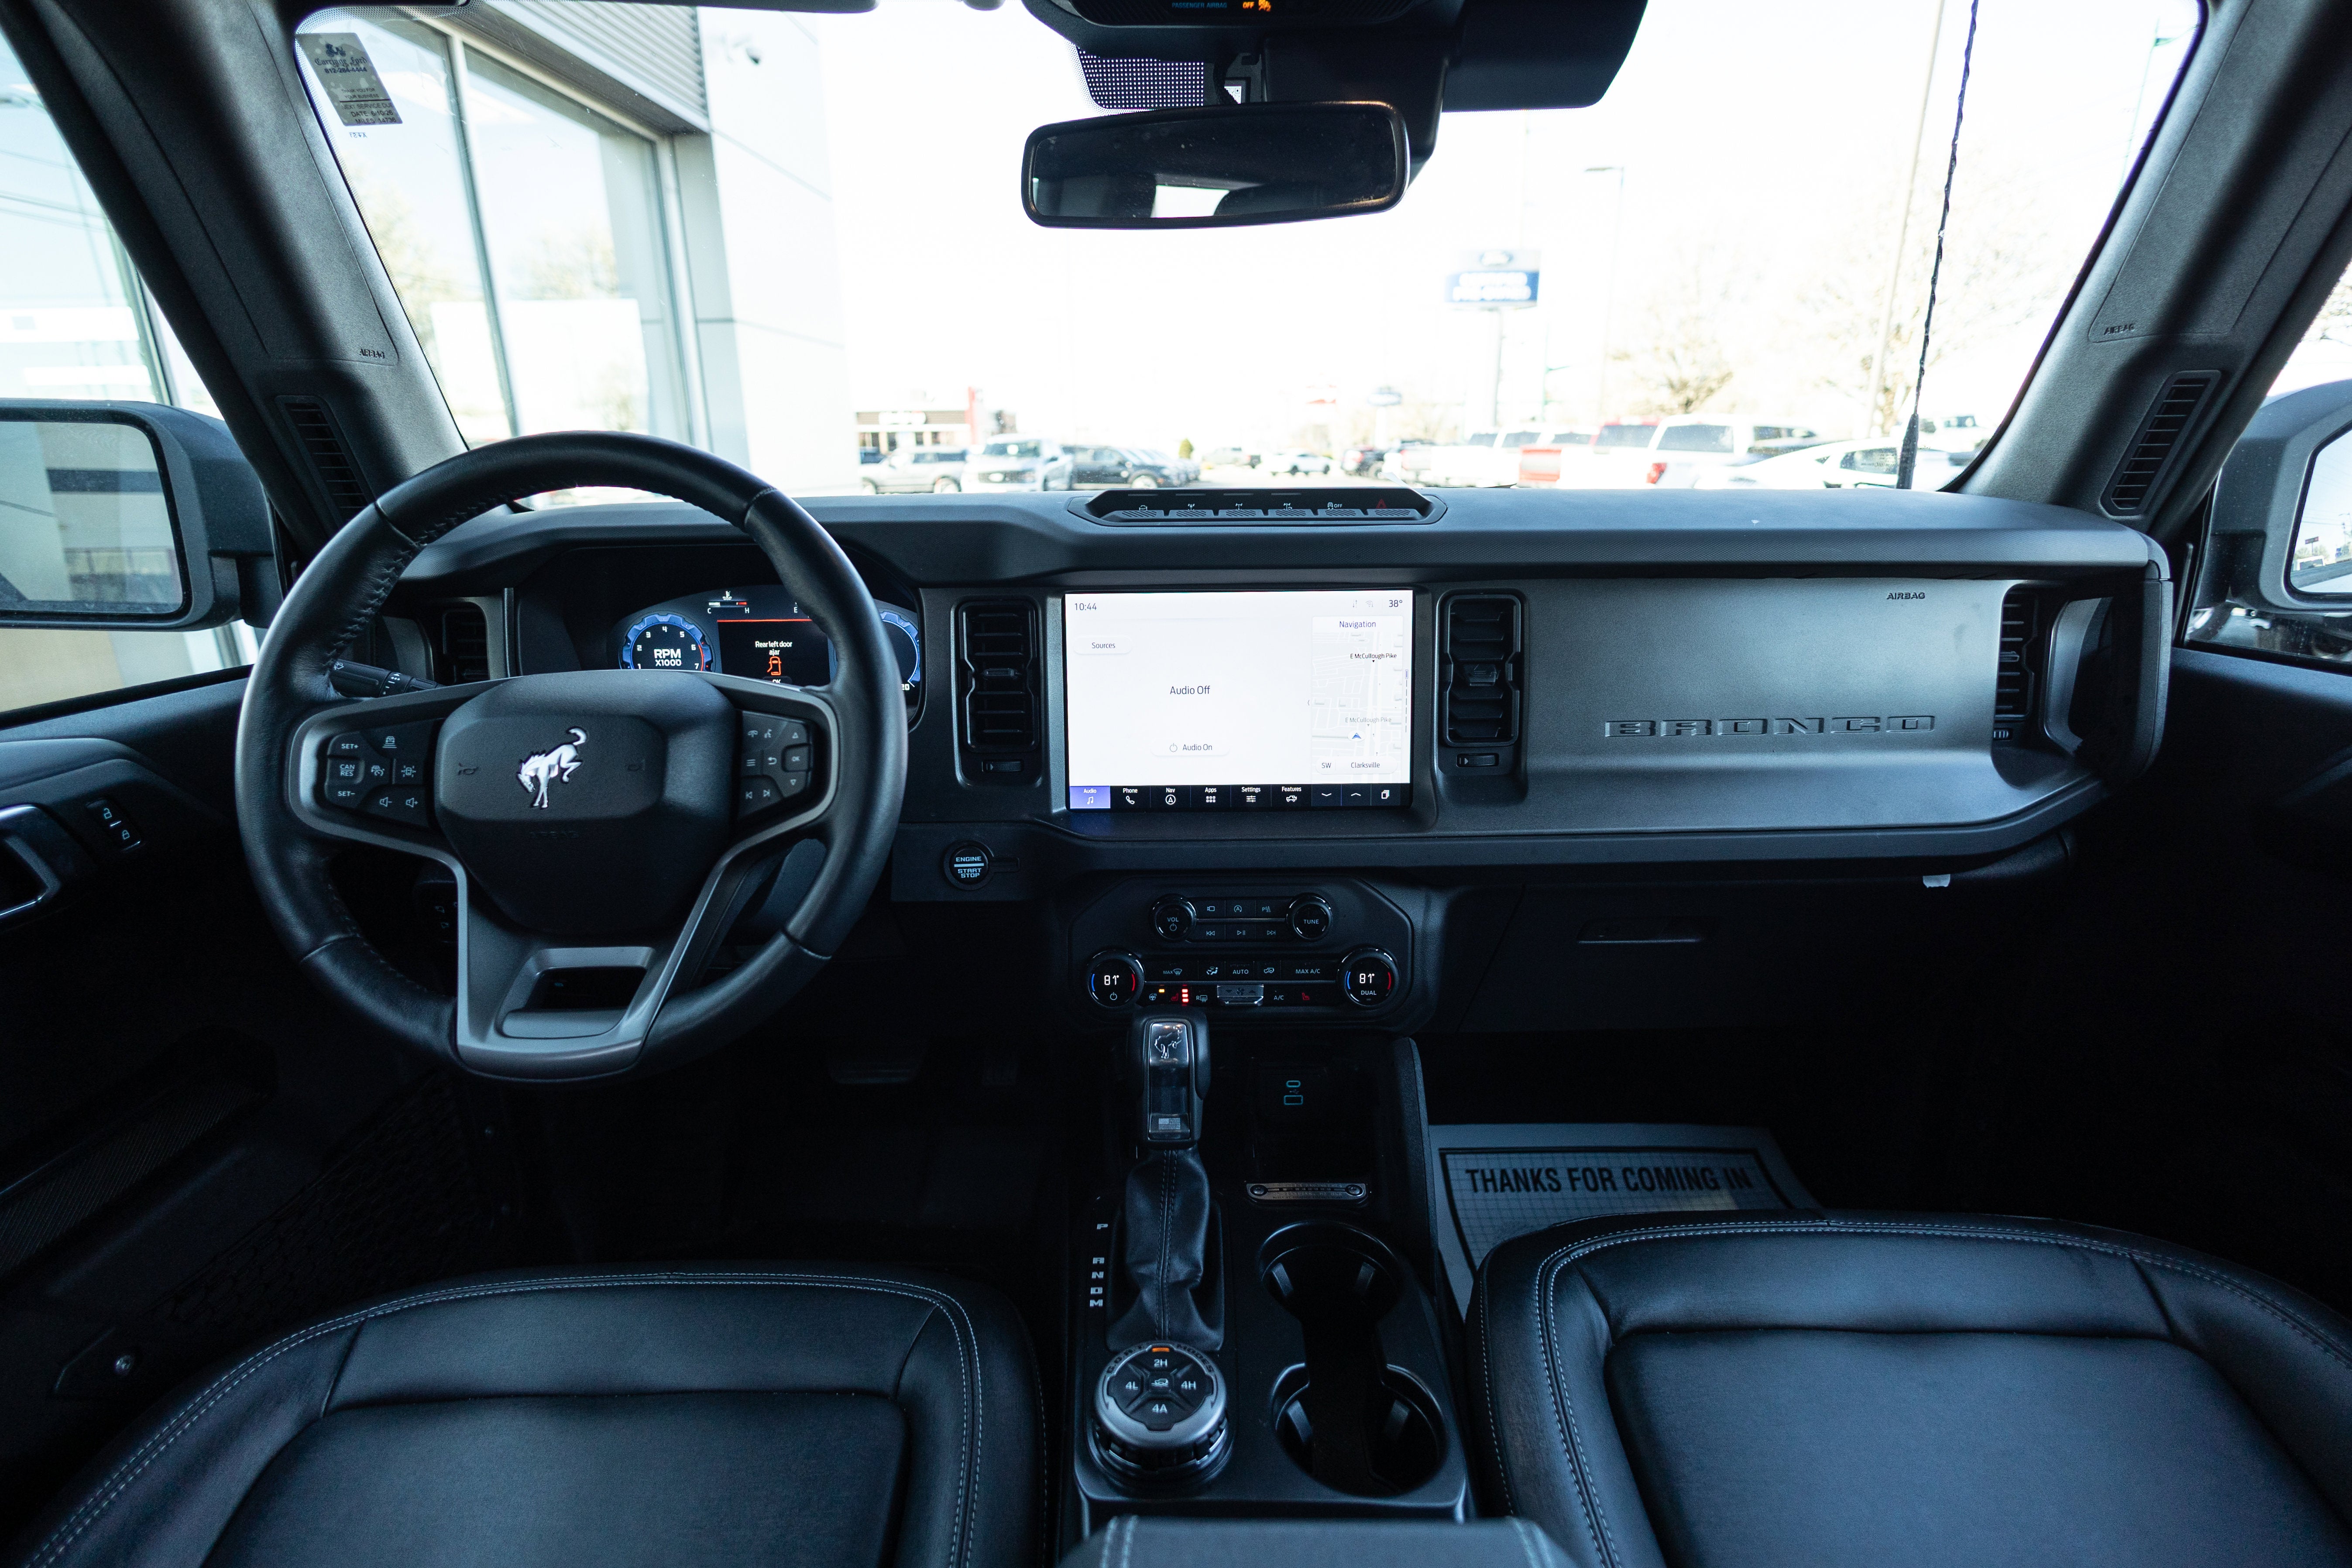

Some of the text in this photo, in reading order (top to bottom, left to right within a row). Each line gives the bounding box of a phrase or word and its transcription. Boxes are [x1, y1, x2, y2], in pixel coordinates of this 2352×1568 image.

[1886, 591, 1925, 600] AIRBAG
[1075, 602, 1097, 611] 10:44
[1389, 599, 1403, 608] 38°
[1339, 620, 1376, 628] Navigation
[654, 648, 681, 659] RPM
[1170, 685, 1210, 695] Audio Off
[1605, 715, 1935, 737] BRONCO
[1104, 974, 1119, 985] 81°
[1359, 973, 1375, 984] 81°
[1466, 1166, 1754, 1193] THANKS FOR COMING IN
[1177, 1344, 1215, 1372] MODES
[1154, 1359, 1167, 1368] 2H
[1125, 1381, 1139, 1390] 4L
[1181, 1380, 1196, 1390] 4H
[1152, 1403, 1167, 1414] 4A
